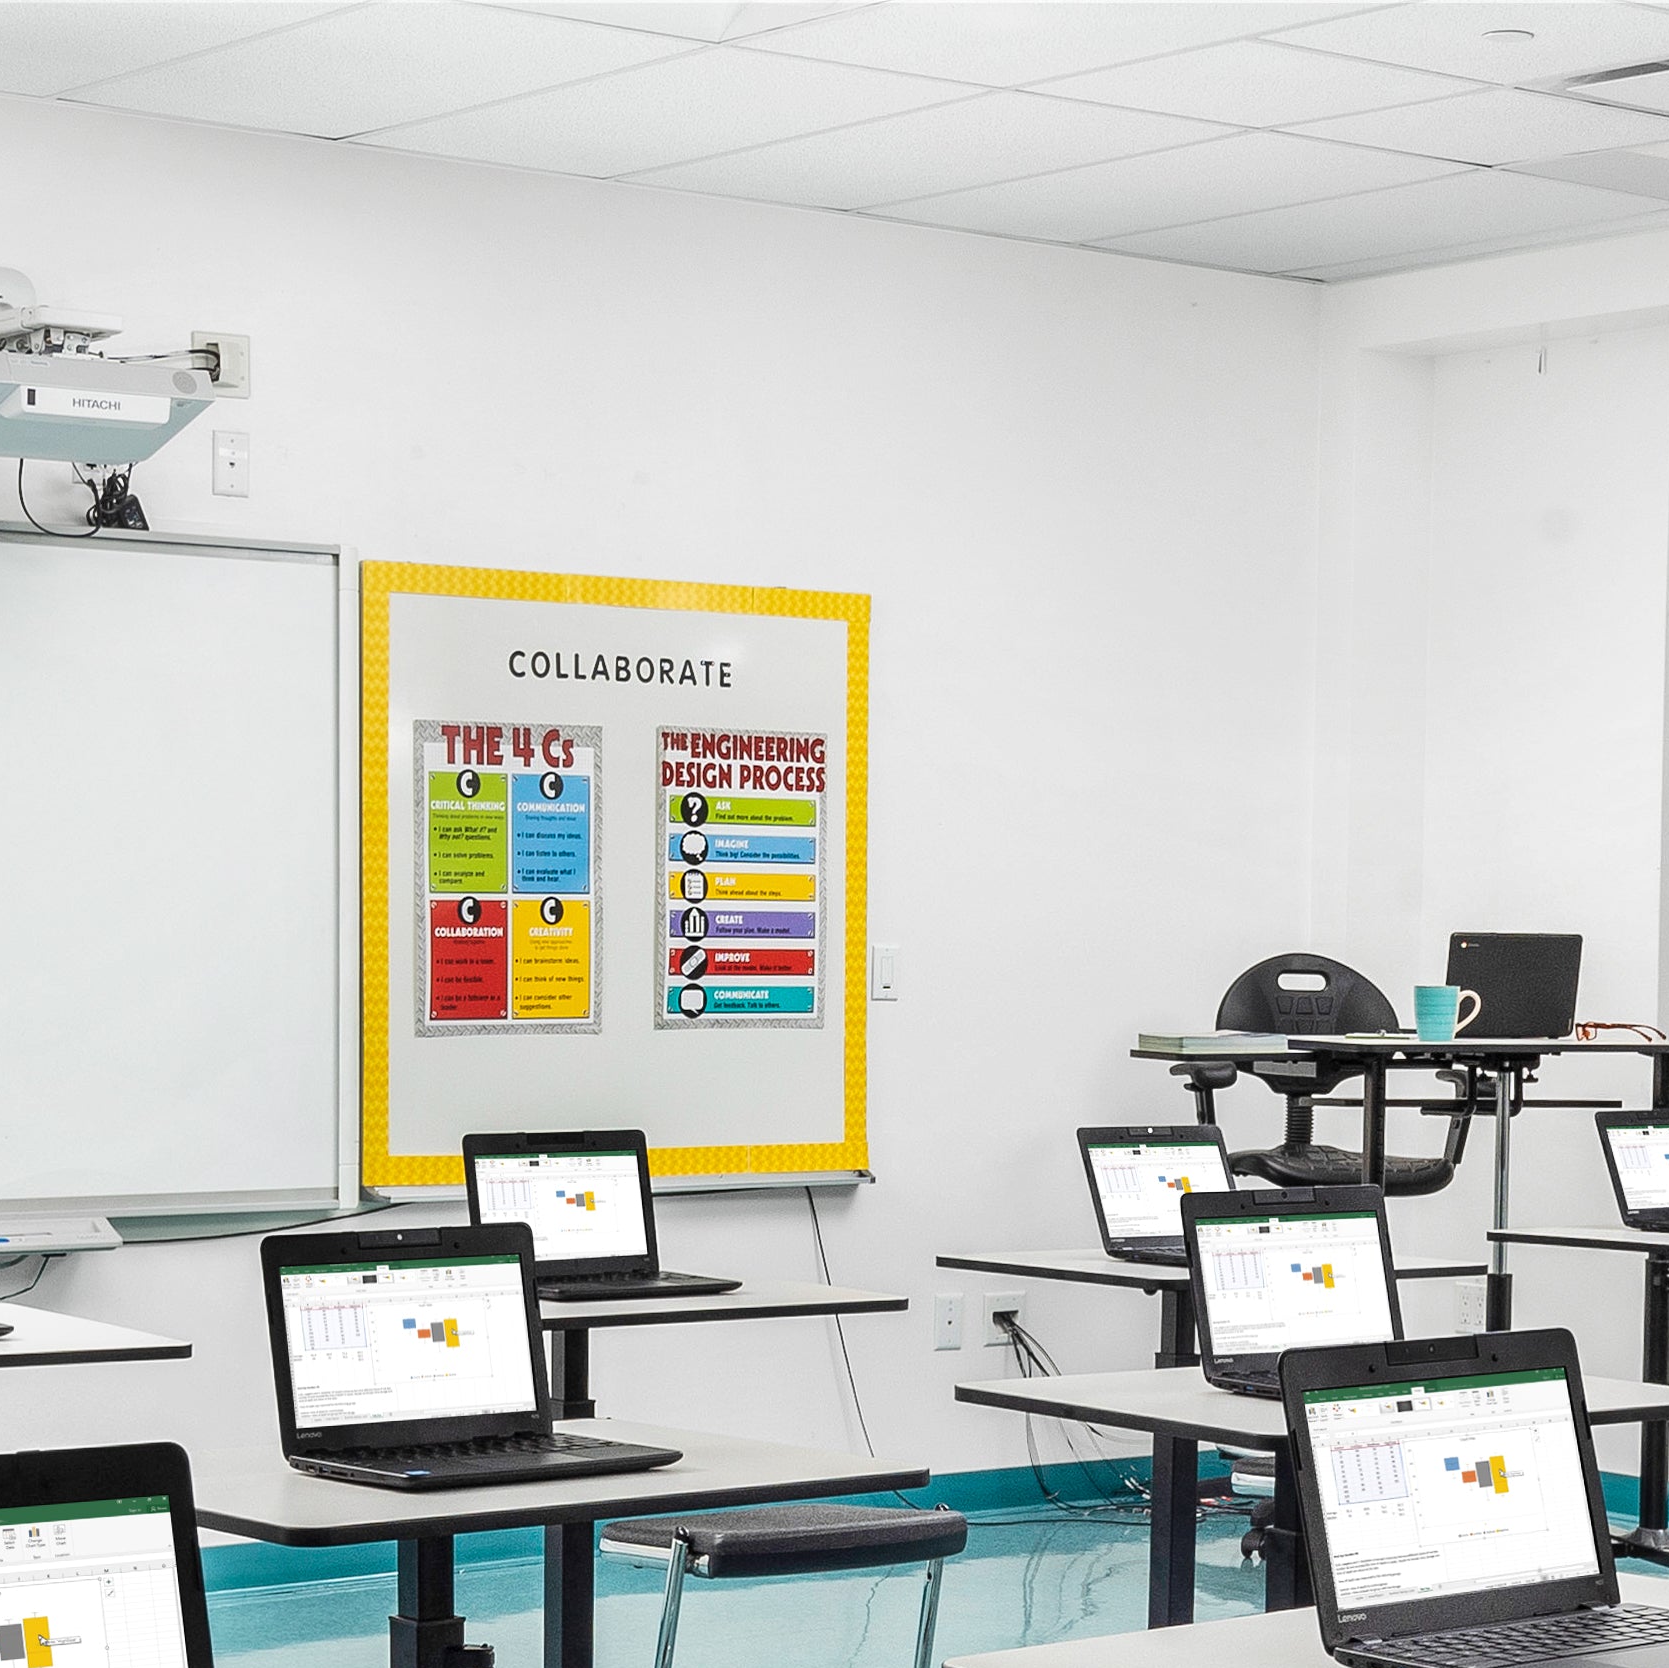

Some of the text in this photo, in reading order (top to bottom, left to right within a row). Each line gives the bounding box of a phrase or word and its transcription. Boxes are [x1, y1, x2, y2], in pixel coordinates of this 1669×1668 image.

[73, 398, 121, 411] HITACHI
[508, 650, 732, 688] COLLABORATE
[441, 725, 574, 768] THE 4 Cs
[661, 732, 826, 764] THE ENGINEERING
[662, 761, 826, 792] DESIGN PROCESS
[461, 772, 473, 796] C
[543, 773, 556, 798] C
[431, 801, 506, 811] CRITICAL THINKING
[516, 802, 585, 813] COMMUNICATION
[716, 802, 732, 811] ASK
[715, 839, 749, 849] IMAGINE
[715, 877, 736, 886] PLAN
[461, 899, 474, 923] C
[543, 899, 556, 923] C
[716, 915, 743, 925] CREATE
[434, 927, 503, 937] COLLABORATION
[529, 927, 573, 937] CREATIVITY
[715, 953, 750, 962] IMPROVE
[714, 990, 769, 1000] COMMUNICATE
[1338, 1612, 1367, 1624] Lenovo
